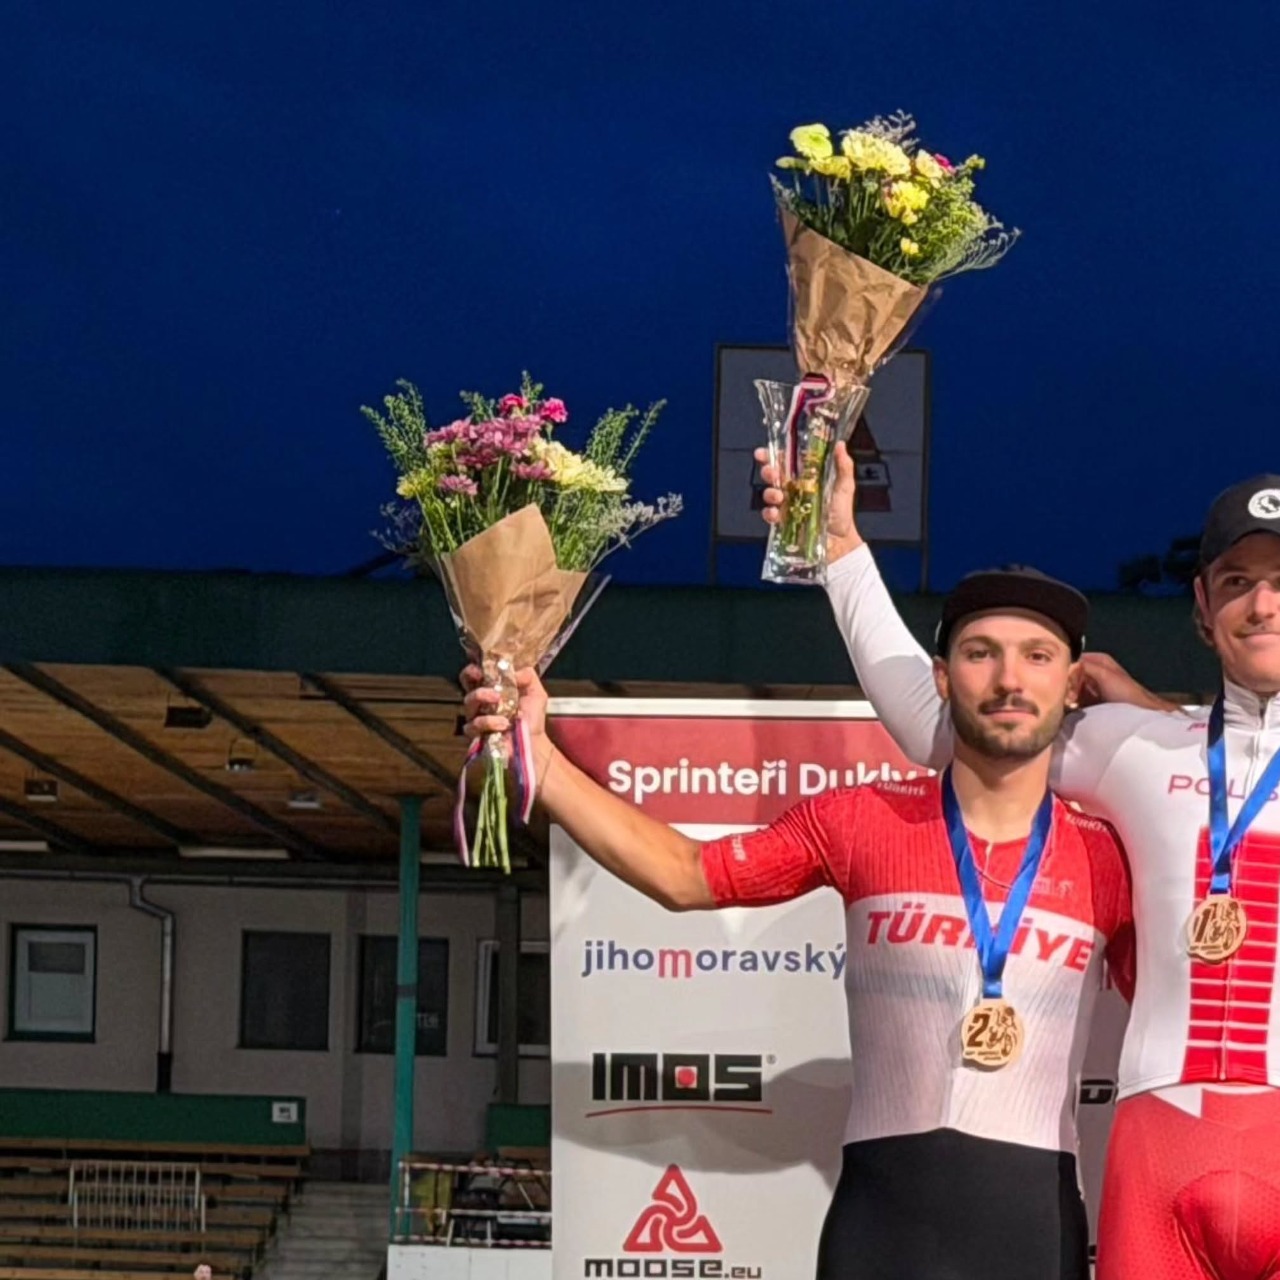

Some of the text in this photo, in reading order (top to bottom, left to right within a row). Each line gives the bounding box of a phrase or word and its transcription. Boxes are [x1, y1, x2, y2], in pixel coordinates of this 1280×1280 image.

[607, 758, 787, 804] Sprinteři
[867, 902, 1096, 974] TÜRİYE
[582, 941, 846, 979] jihomoravský
[967, 1013, 990, 1047] 2
